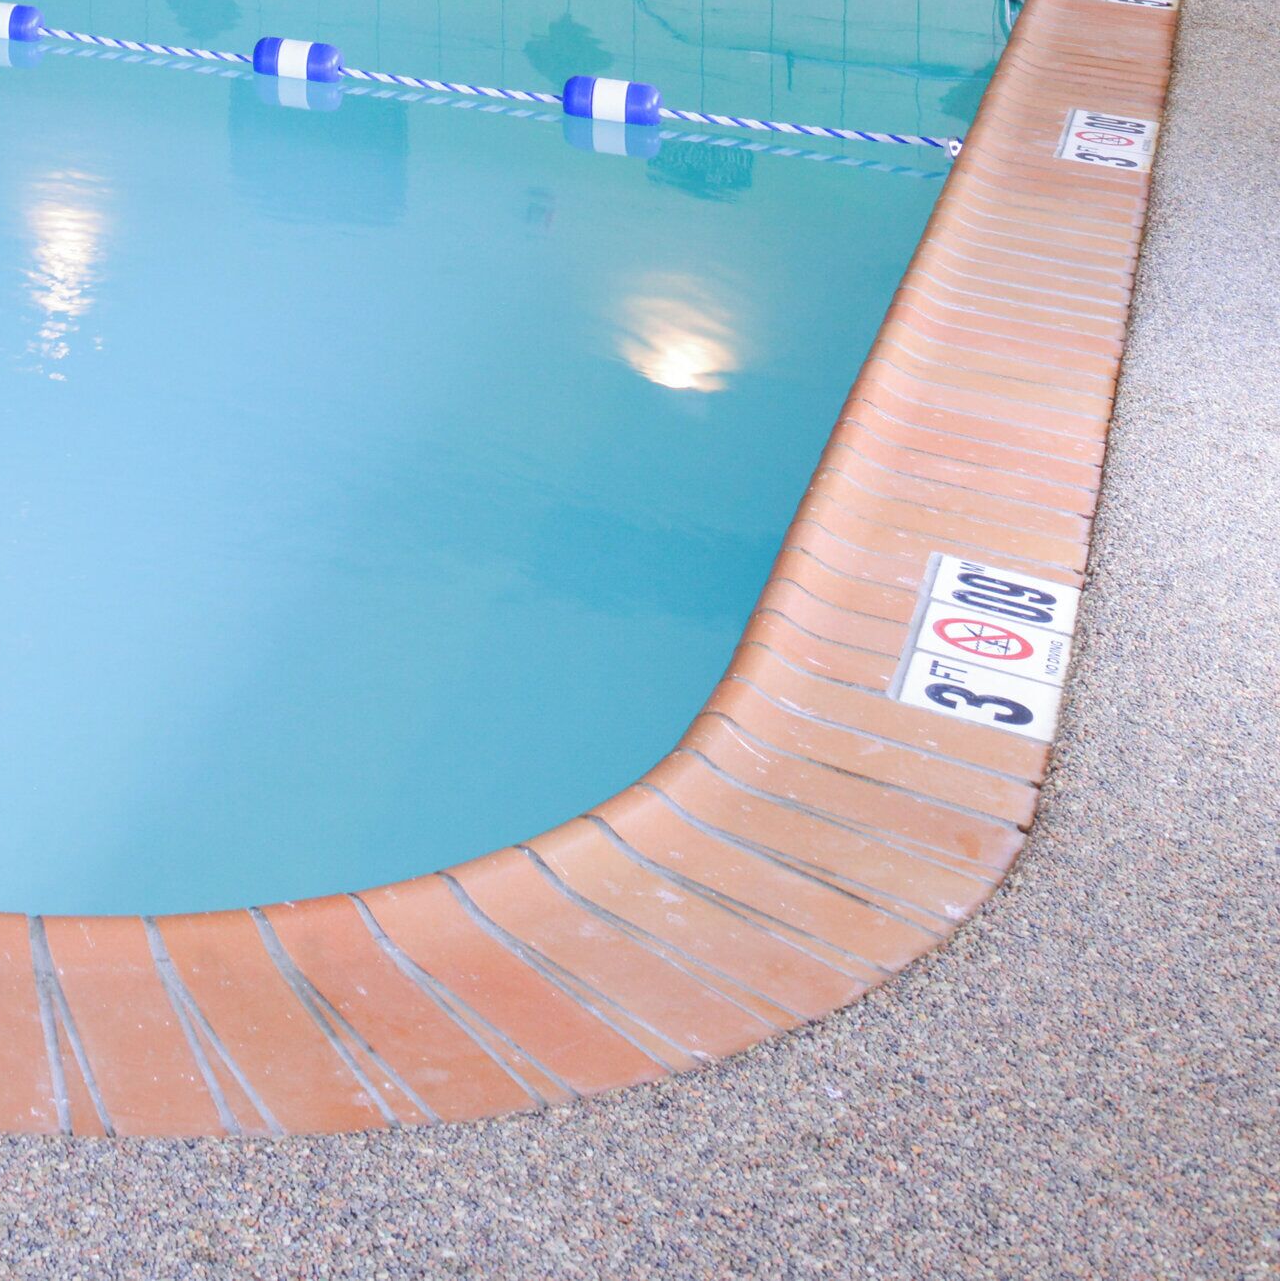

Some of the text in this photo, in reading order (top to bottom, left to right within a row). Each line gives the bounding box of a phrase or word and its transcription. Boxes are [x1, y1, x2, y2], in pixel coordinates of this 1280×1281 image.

[1074, 153, 1138, 168] 3
[960, 561, 986, 575] M
[1044, 640, 1063, 675] NO DIVING
[924, 660, 1034, 725] 3 FT
